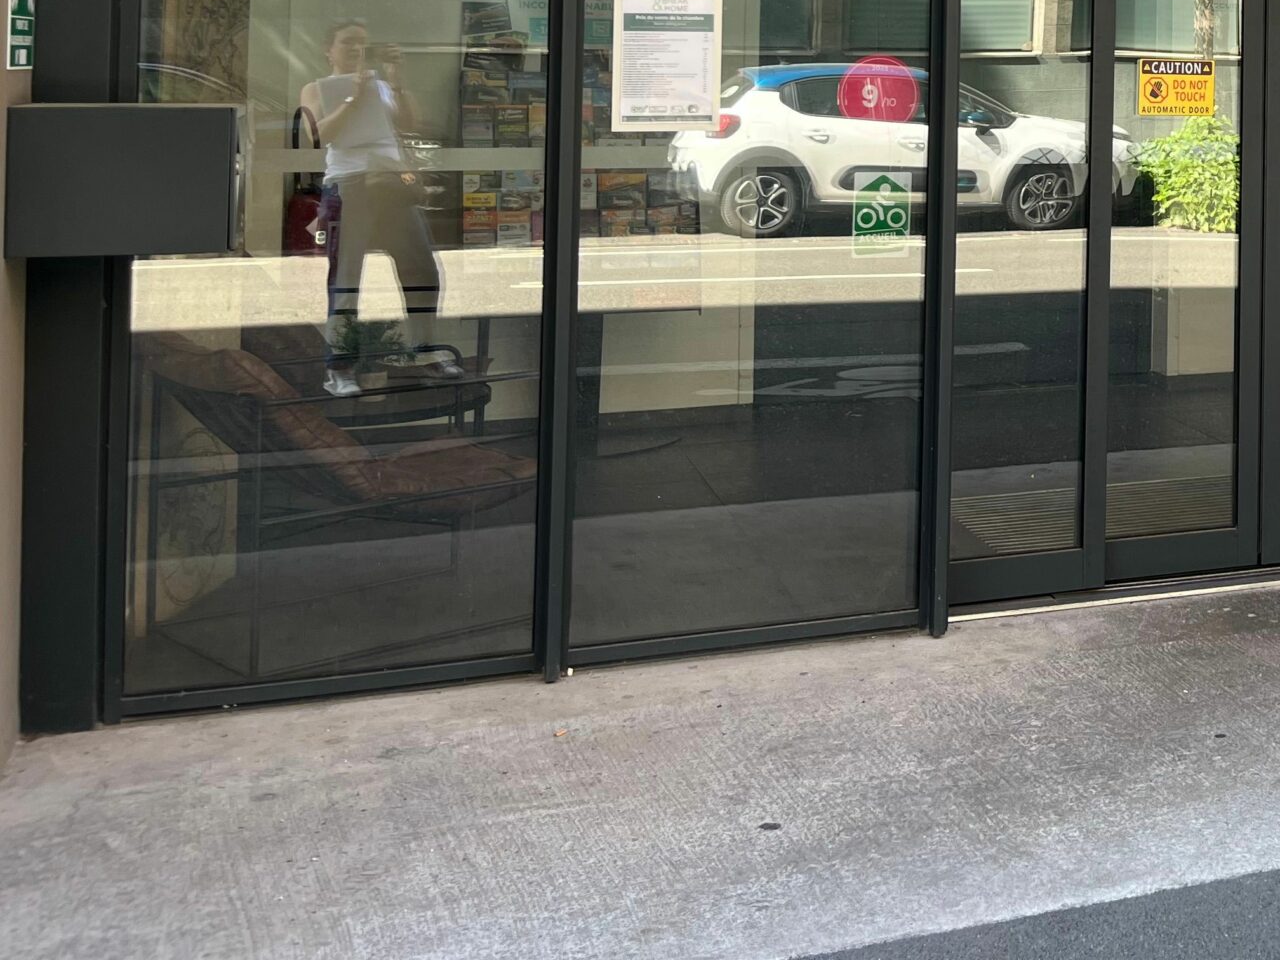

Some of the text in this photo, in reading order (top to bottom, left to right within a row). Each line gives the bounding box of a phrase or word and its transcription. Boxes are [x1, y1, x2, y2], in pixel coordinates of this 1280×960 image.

[1151, 61, 1202, 74] CAUTION
[1172, 79, 1209, 90] DO NOT
[861, 84, 879, 108] 9
[1174, 91, 1206, 102] TOUCH
[1141, 105, 1210, 115] AUTOMATIC DOOR
